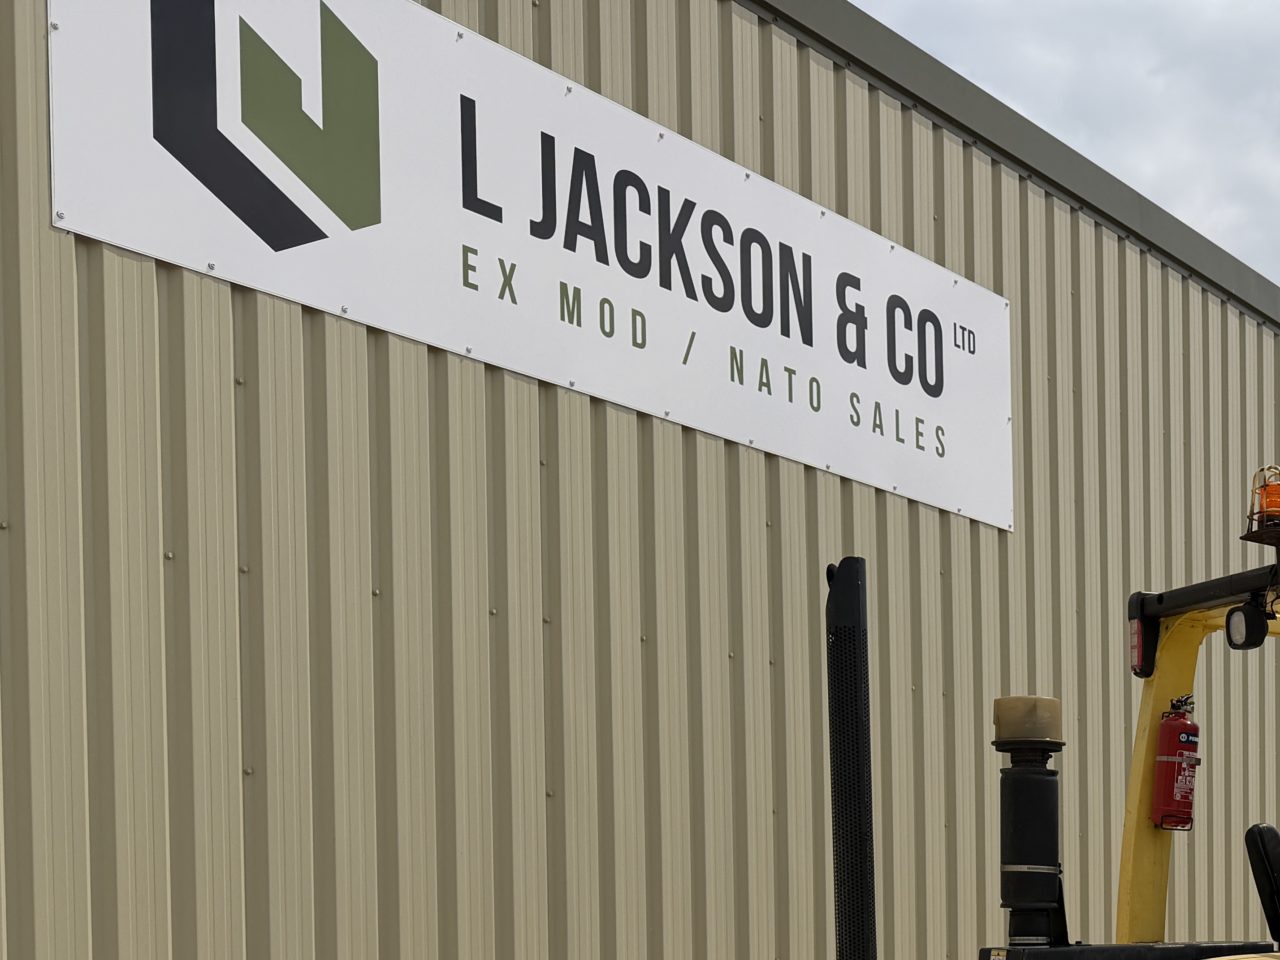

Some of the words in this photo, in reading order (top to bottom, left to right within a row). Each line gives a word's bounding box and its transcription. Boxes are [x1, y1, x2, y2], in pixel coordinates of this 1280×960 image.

[460, 94, 502, 223] L
[530, 131, 813, 347] JACKSON
[836, 272, 868, 369] &
[887, 295, 944, 398] CO
[954, 323, 975, 354] LTD
[462, 245, 517, 305] EX
[560, 281, 647, 349] MOD
[682, 331, 696, 365] /
[730, 346, 821, 412] NATO
[850, 392, 945, 457] SALES
